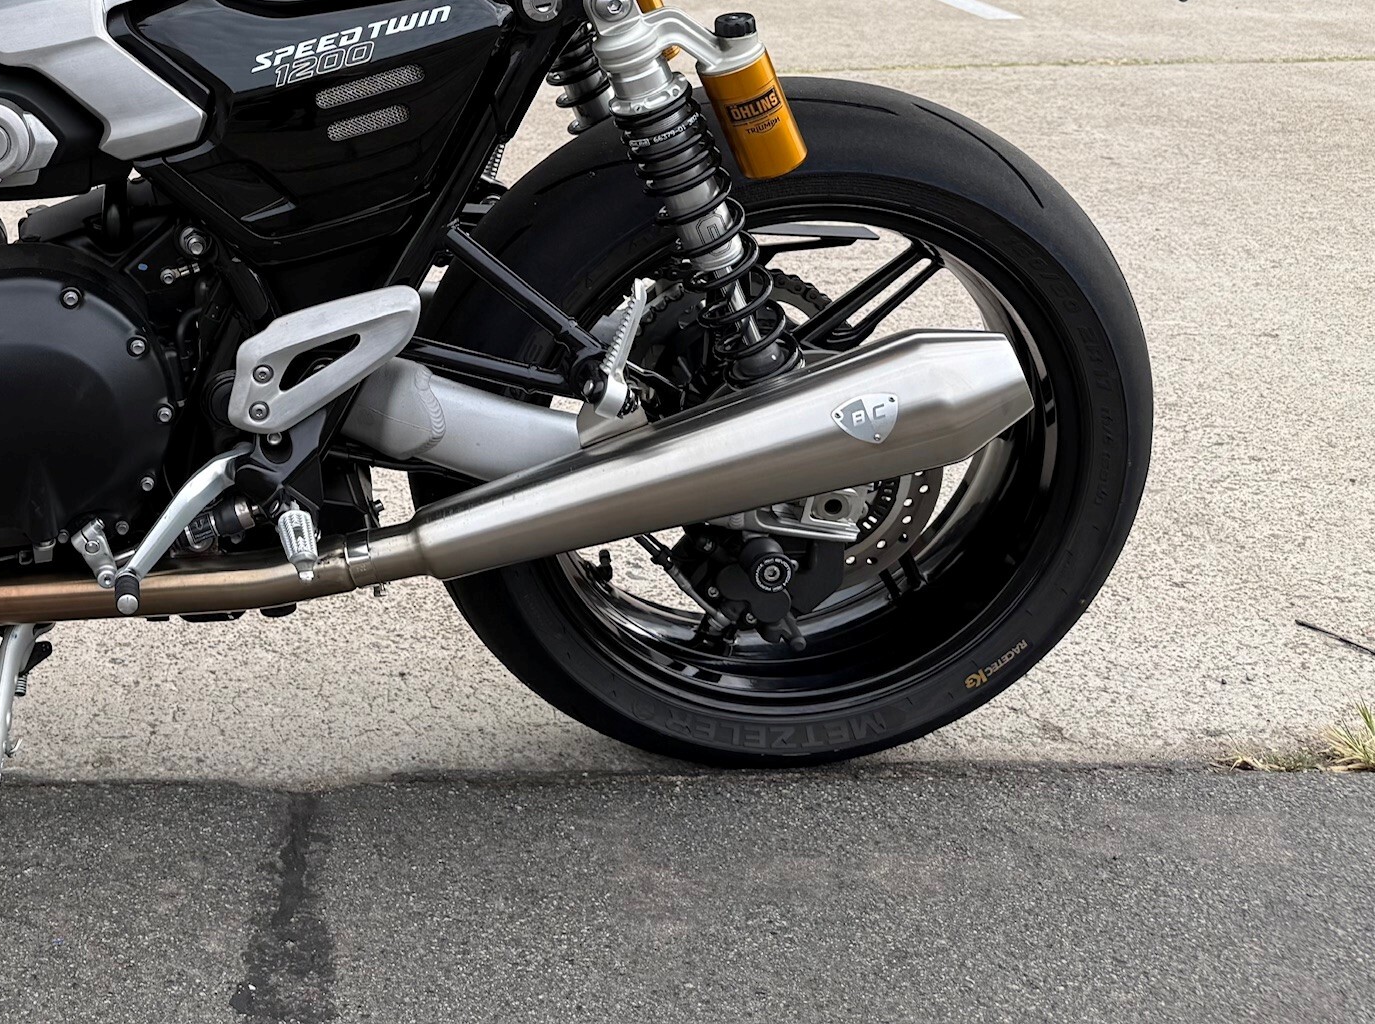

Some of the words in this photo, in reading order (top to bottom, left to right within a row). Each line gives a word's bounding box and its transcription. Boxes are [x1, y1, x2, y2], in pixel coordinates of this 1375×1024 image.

[251, 26, 364, 73] SPEED
[368, 5, 452, 39] TWIN
[274, 41, 375, 88] 1200
[728, 90, 779, 121] ÖHLINS
[745, 116, 781, 135] TRIUMPH
[984, 639, 1029, 677] RACETEC
[664, 708, 888, 750] METZELER
